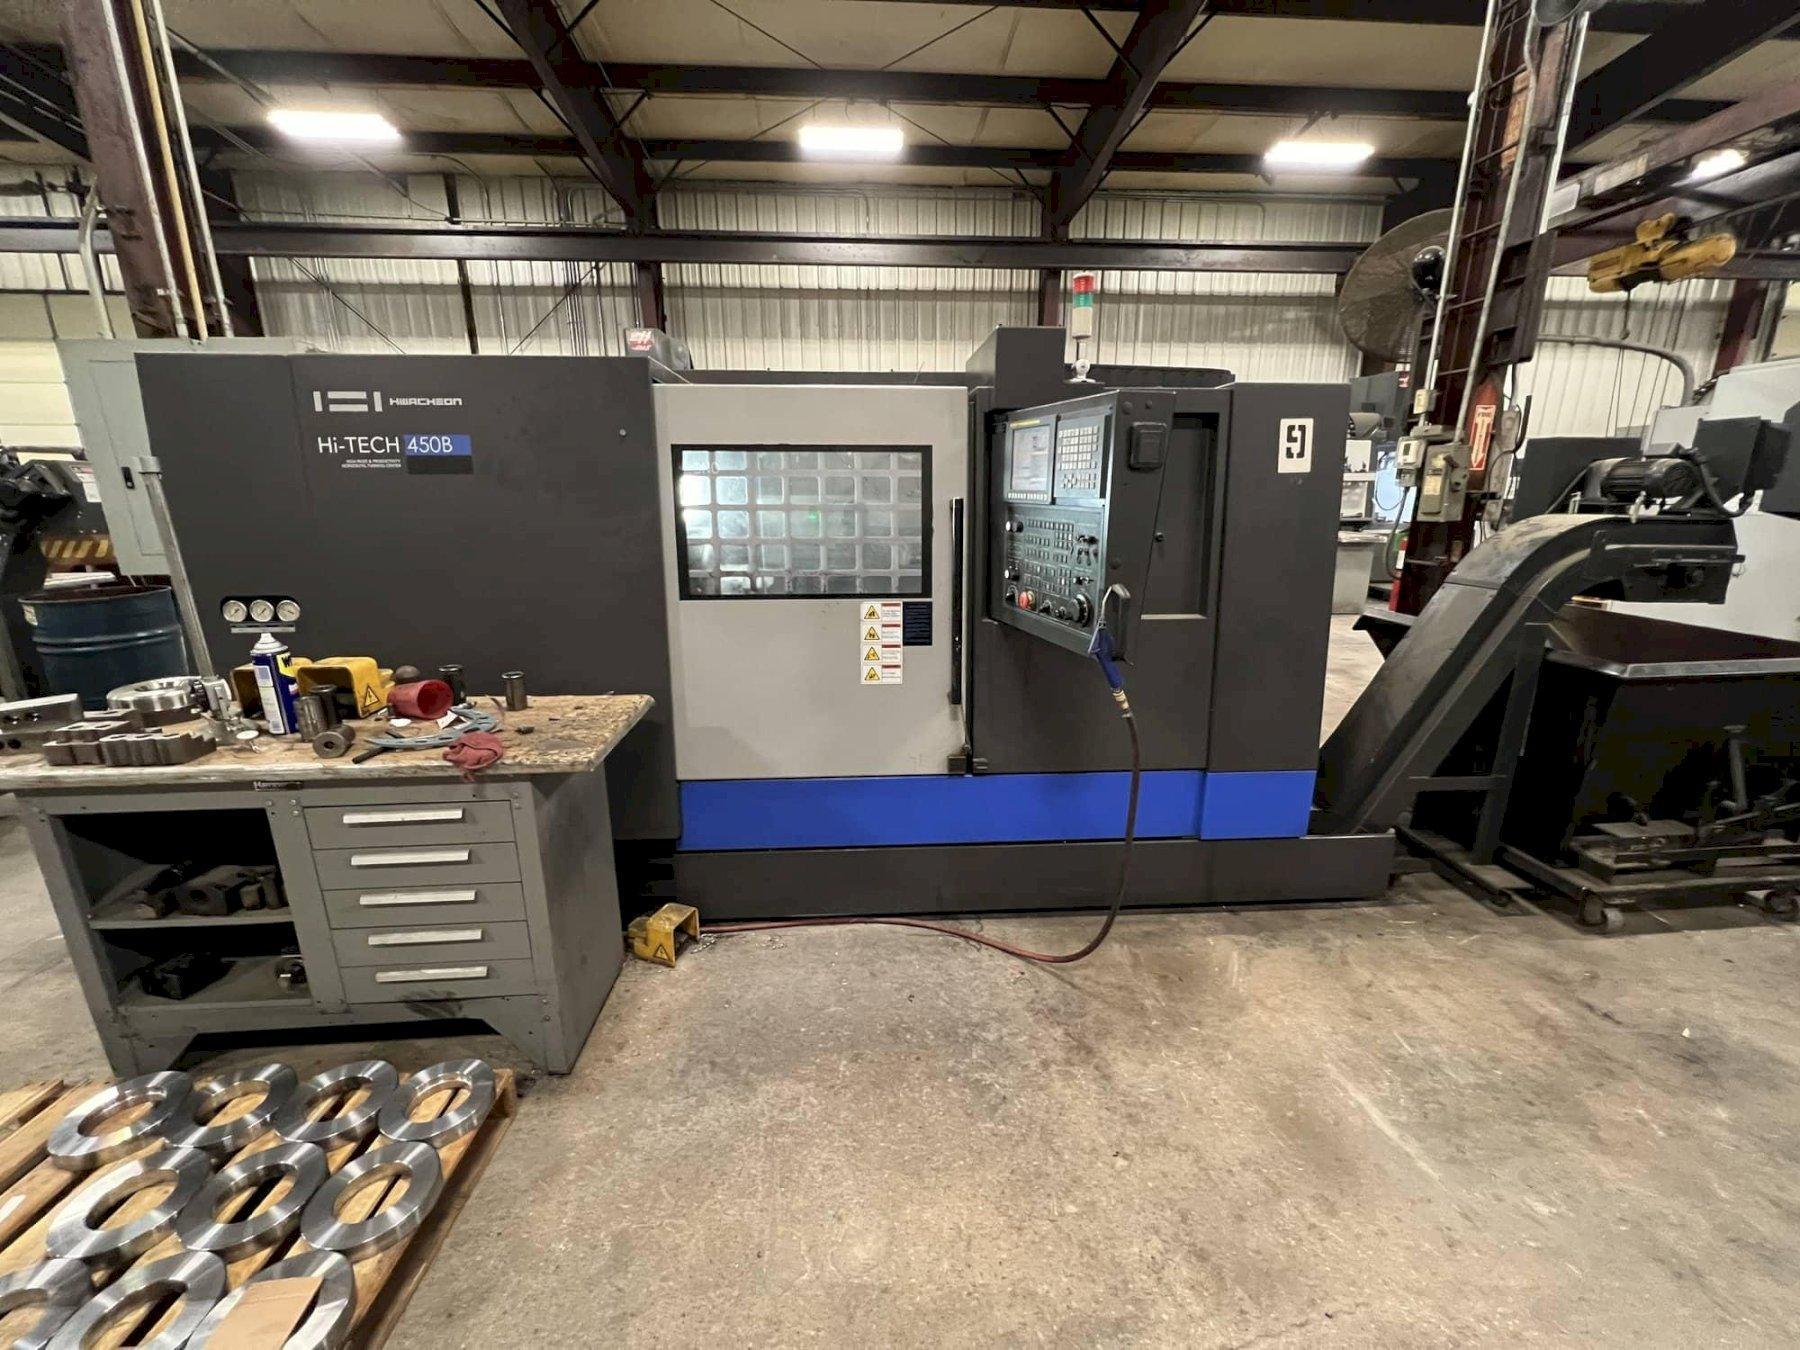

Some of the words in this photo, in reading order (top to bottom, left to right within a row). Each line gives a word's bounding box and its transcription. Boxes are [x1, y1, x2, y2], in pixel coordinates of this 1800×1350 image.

[317, 436, 401, 454] Hi-TECH
[407, 435, 454, 454] 450B
[1285, 424, 1307, 459] 9
